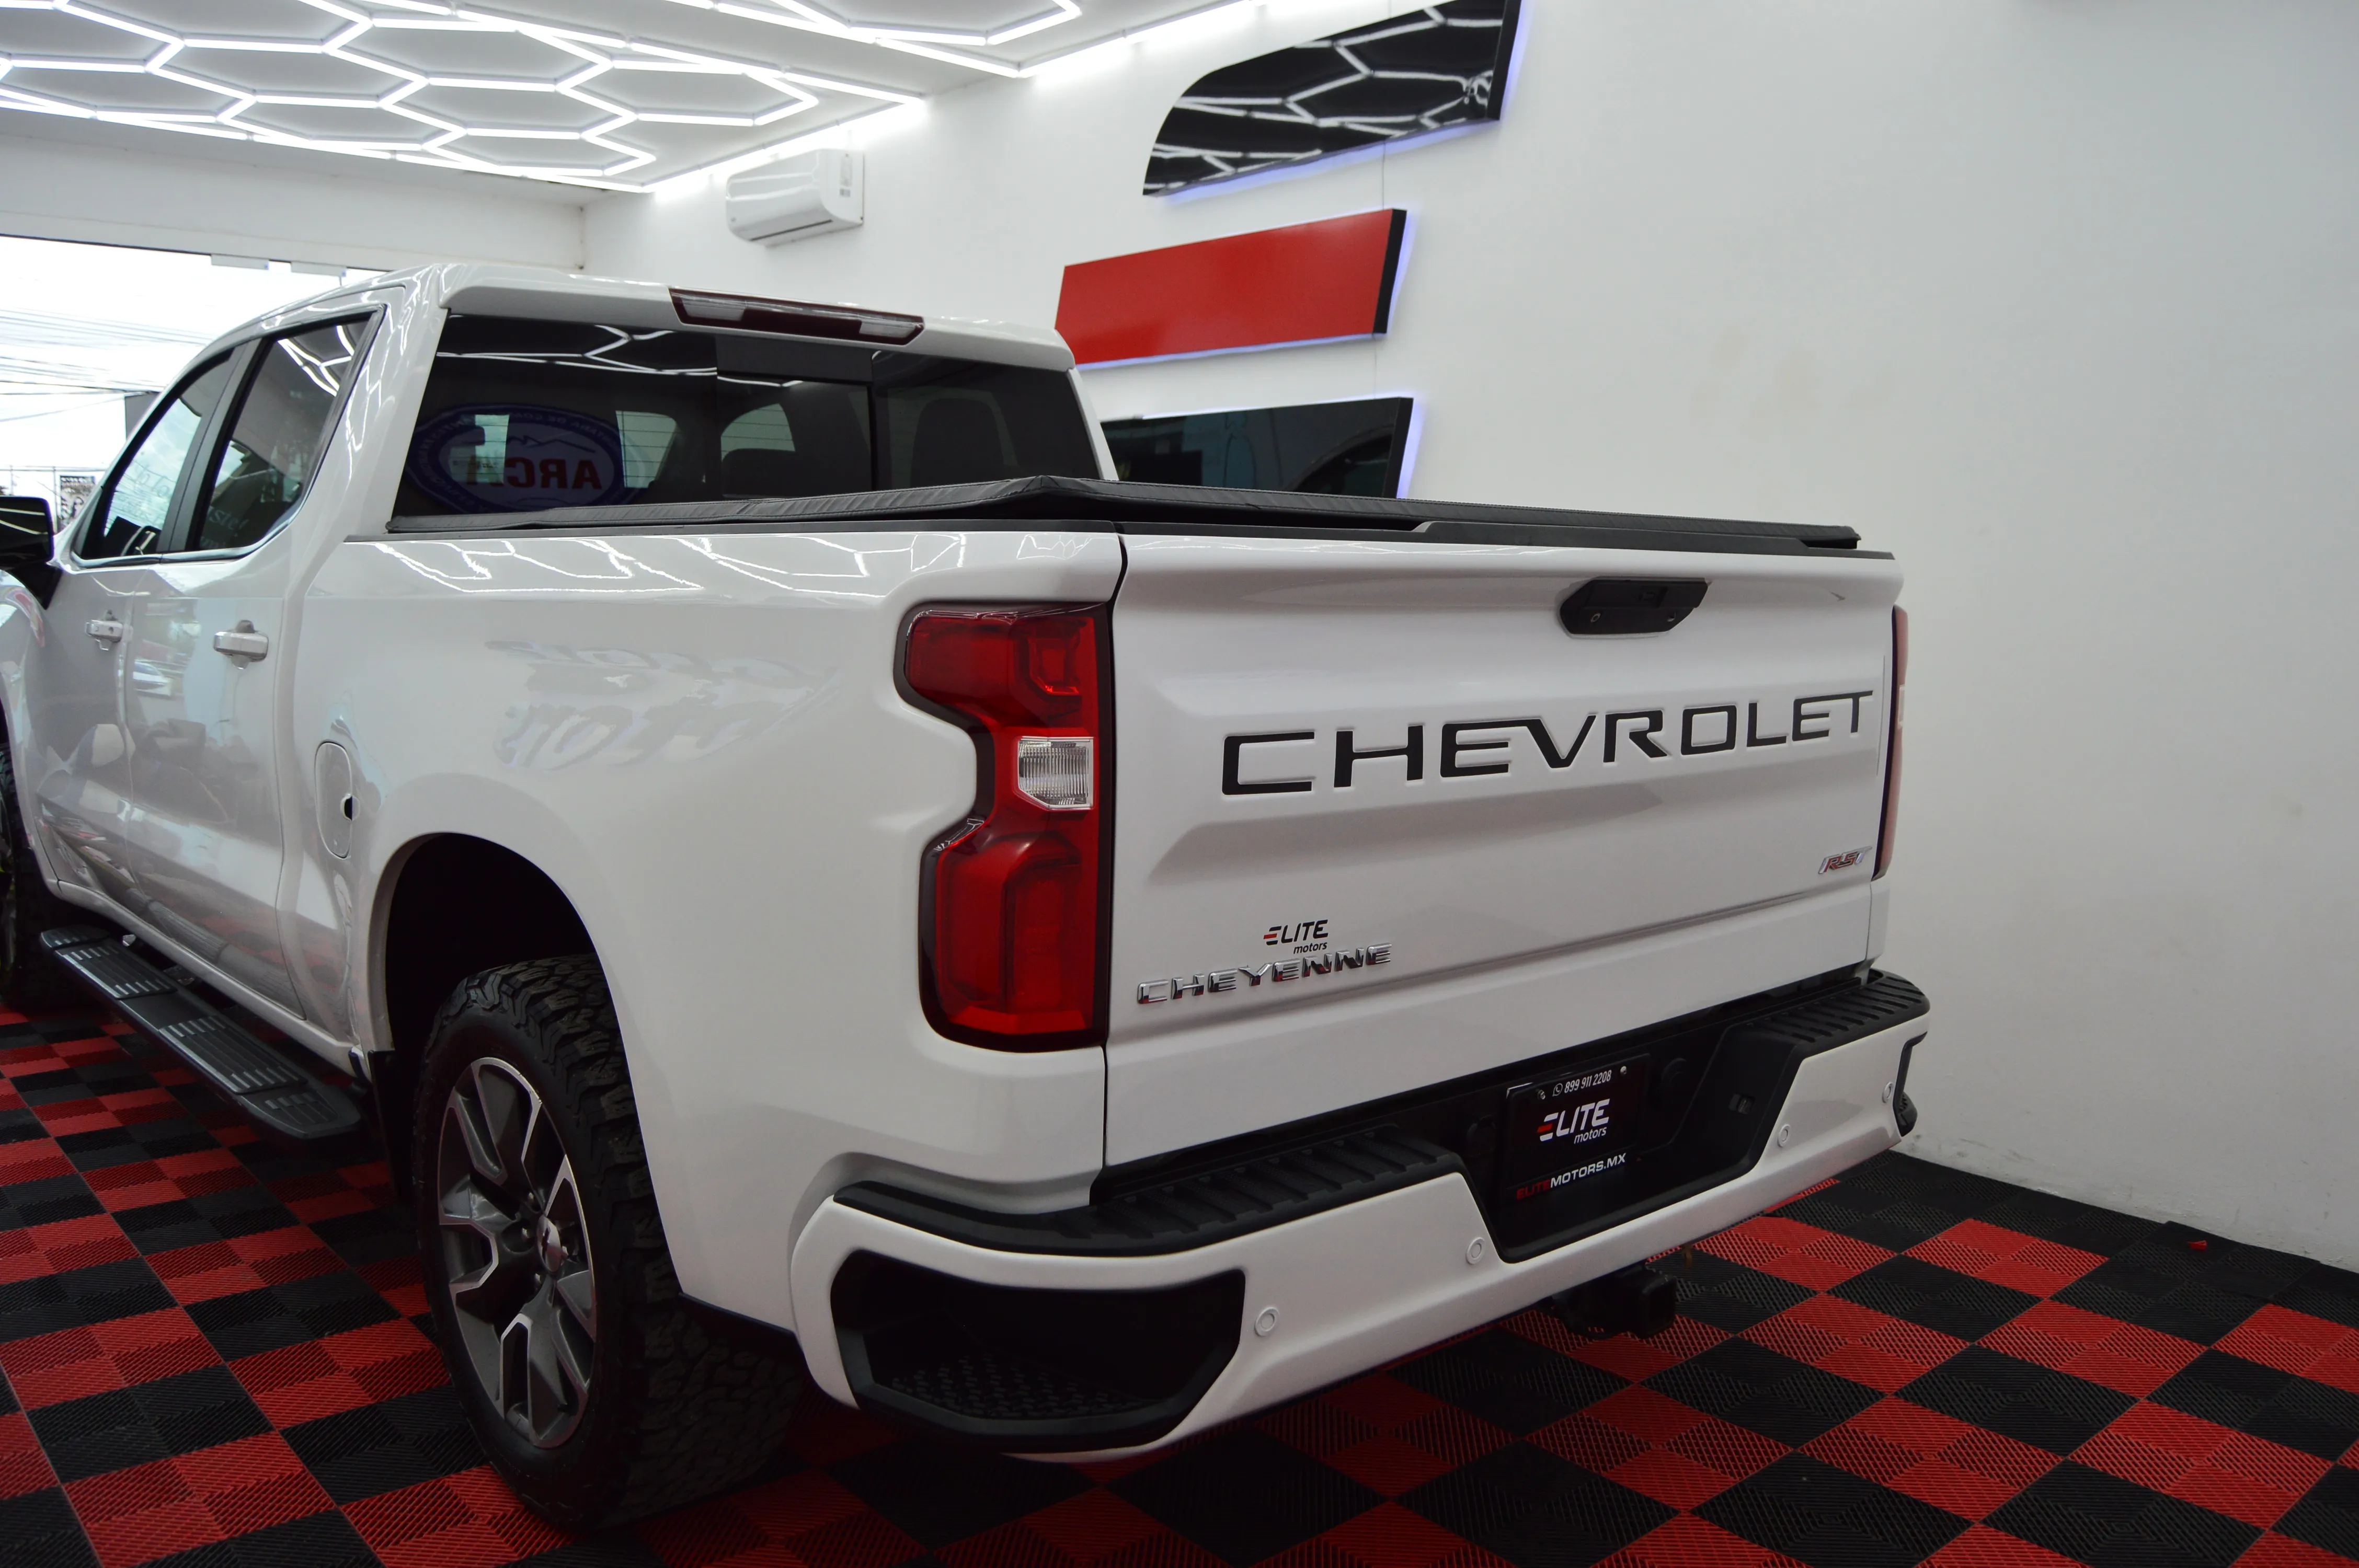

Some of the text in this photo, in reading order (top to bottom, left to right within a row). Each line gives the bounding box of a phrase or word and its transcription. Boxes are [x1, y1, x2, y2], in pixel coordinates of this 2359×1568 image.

[1220, 690, 1873, 795] CHEVROLET
[1818, 846, 1873, 874] RST
[1263, 919, 1329, 946] ELITE
[1293, 942, 1328, 955] motors
[1137, 942, 1392, 1005] CHEYENNE
[1564, 1069, 1612, 1094] 899 911 2208
[1537, 1098, 1610, 1142] ELITE
[1574, 1127, 1607, 1145] motors
[1516, 1152, 1627, 1201] ELITEMOTORS.MX
